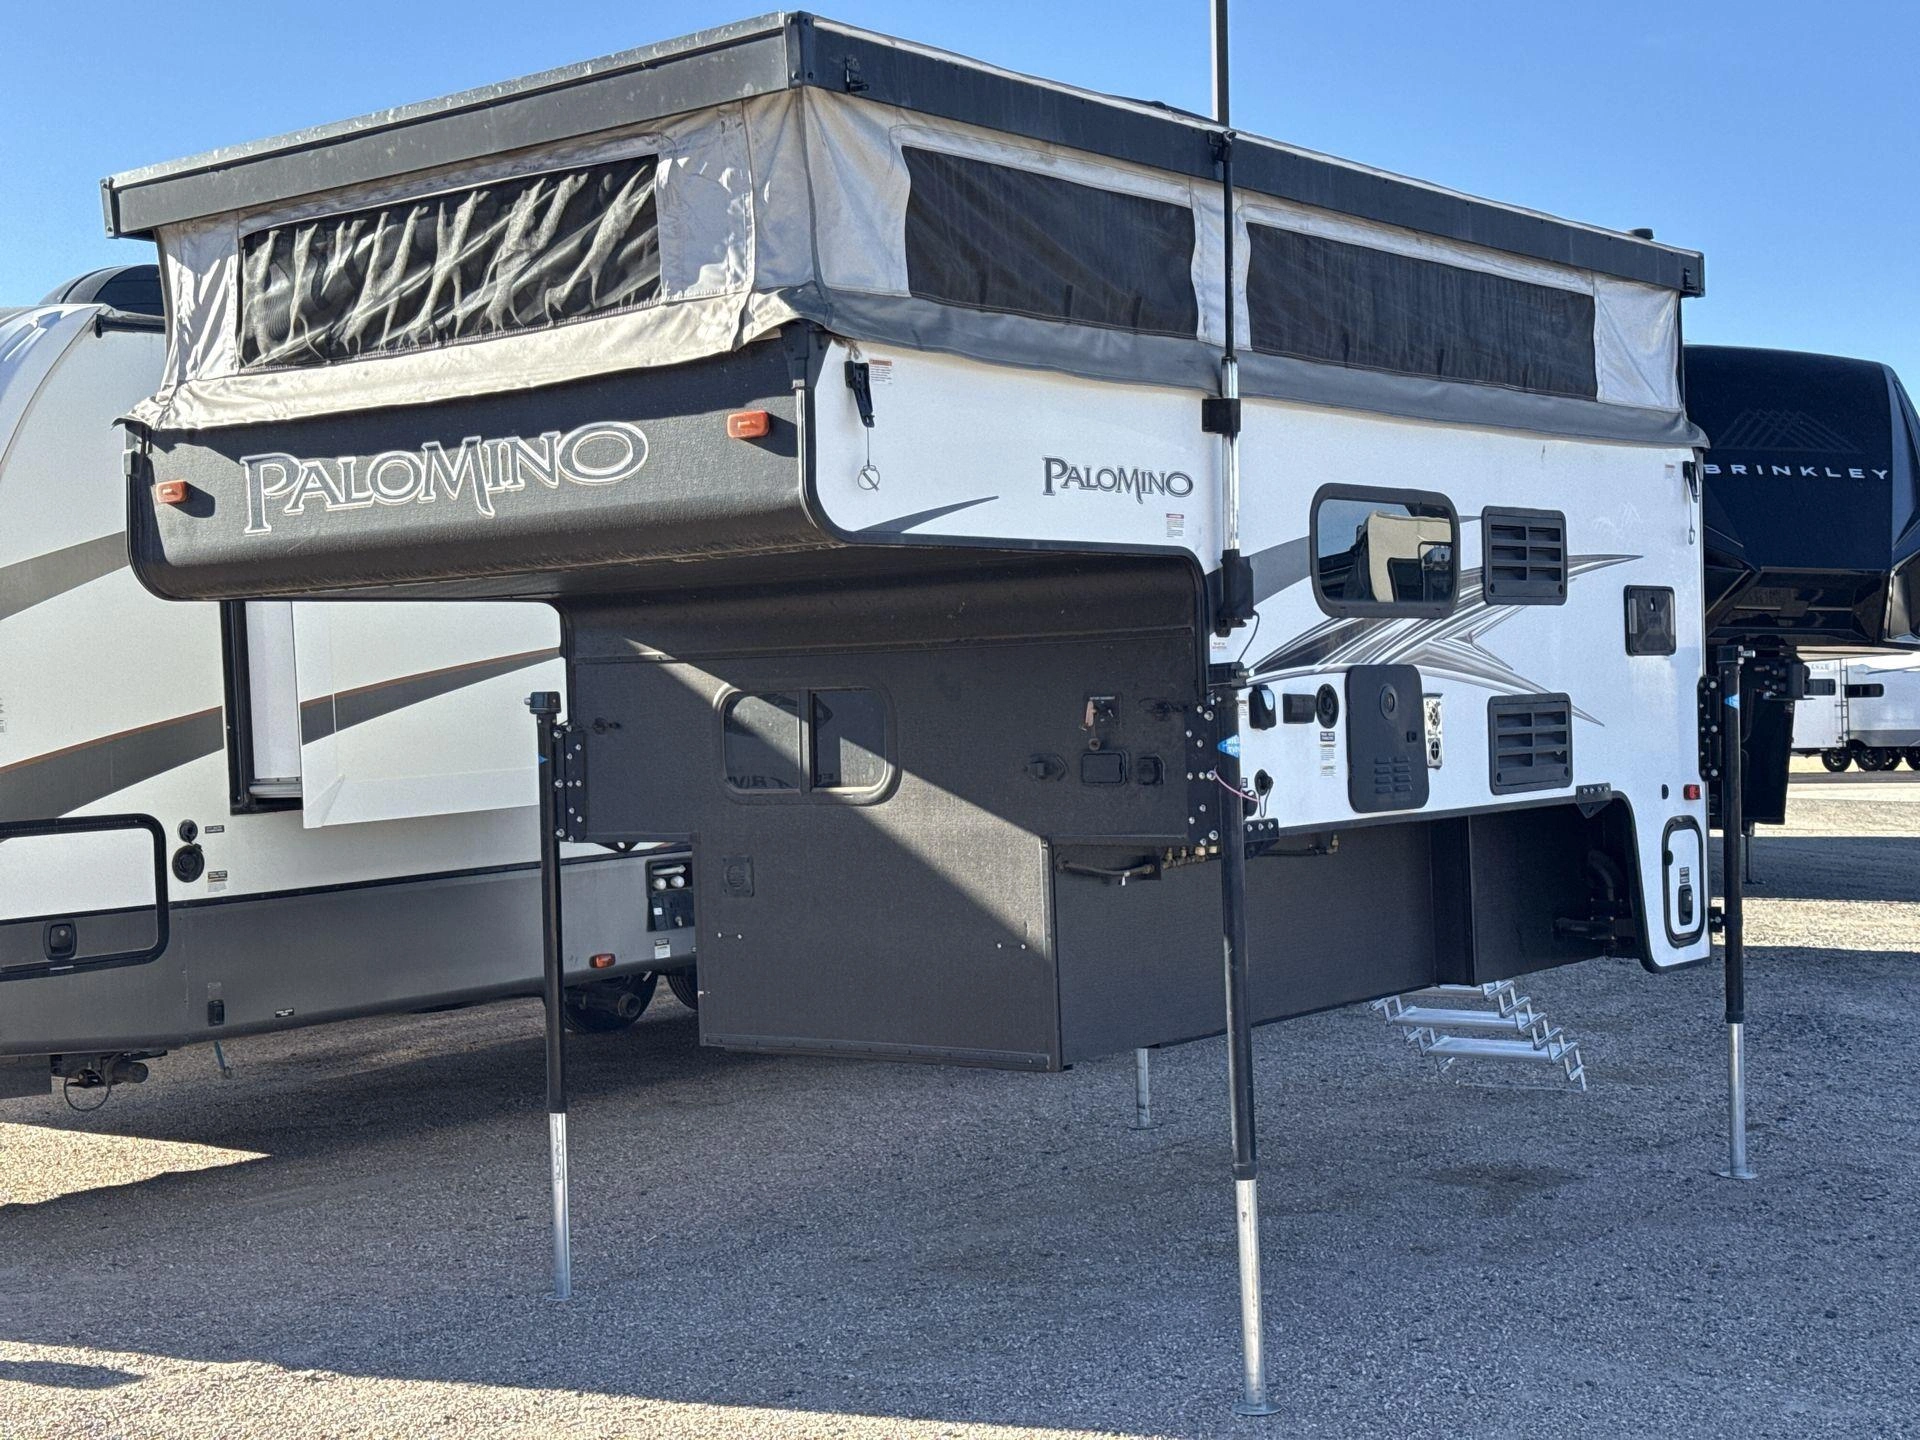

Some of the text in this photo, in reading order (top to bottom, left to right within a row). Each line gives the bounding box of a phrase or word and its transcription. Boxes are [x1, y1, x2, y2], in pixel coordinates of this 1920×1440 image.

[240, 421, 649, 535] PALOMINO
[1042, 455, 1194, 504] PALOMINO
[1703, 464, 1888, 480] BRINKLEY
